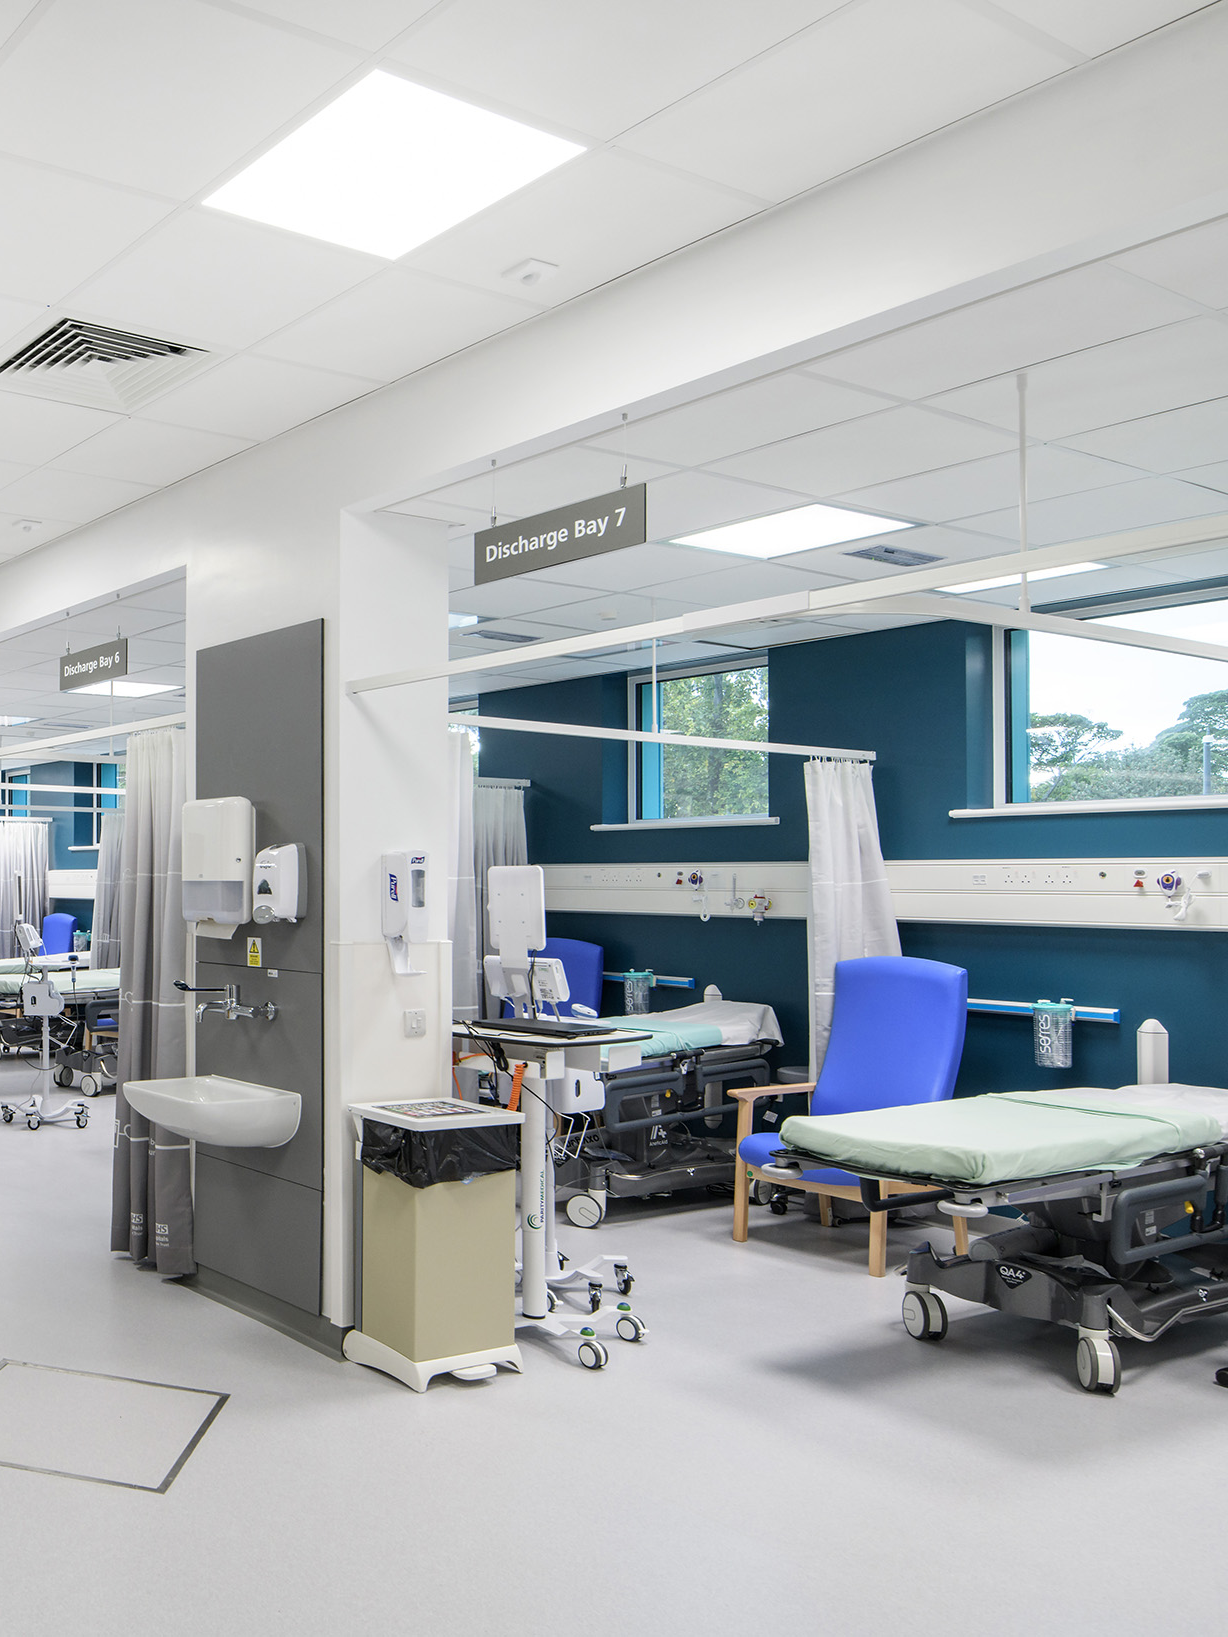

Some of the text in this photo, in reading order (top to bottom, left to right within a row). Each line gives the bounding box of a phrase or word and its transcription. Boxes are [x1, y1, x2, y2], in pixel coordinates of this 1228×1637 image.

[485, 507, 626, 562] Discharge Bay 7
[64, 651, 120, 677] Discharge Bay 6
[1038, 1014, 1051, 1053] serres
